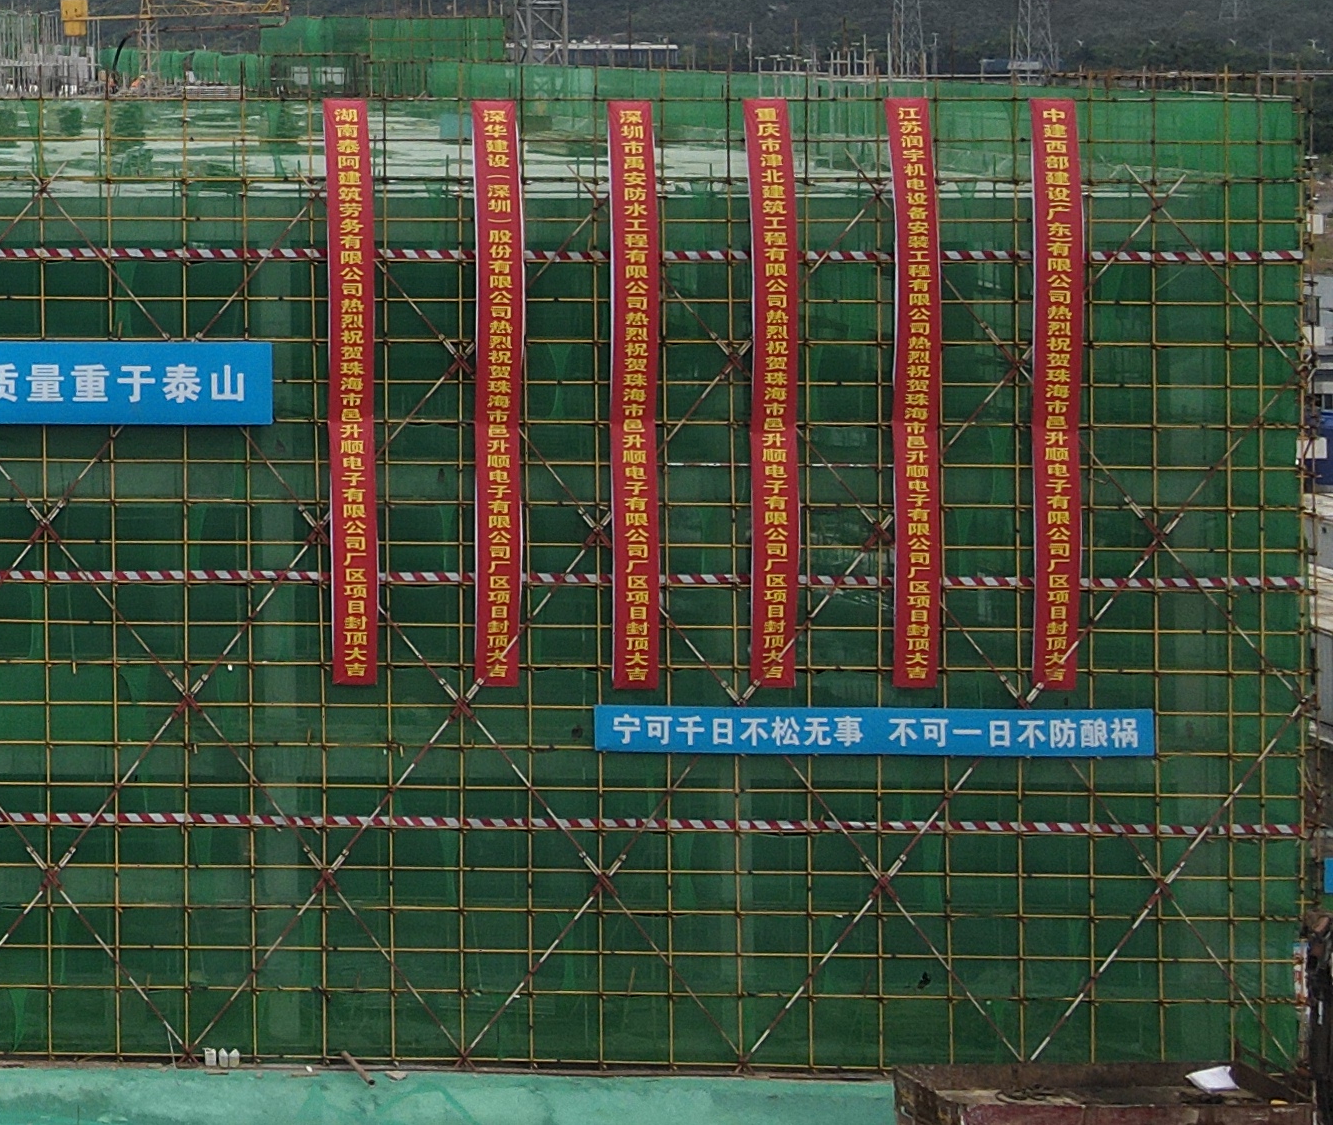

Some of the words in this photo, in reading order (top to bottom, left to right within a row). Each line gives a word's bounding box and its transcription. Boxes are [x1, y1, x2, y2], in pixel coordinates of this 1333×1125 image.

[612, 714, 863, 746] 宁可千日不松无事
[888, 718, 1139, 749] 不可一日不防酿祸
